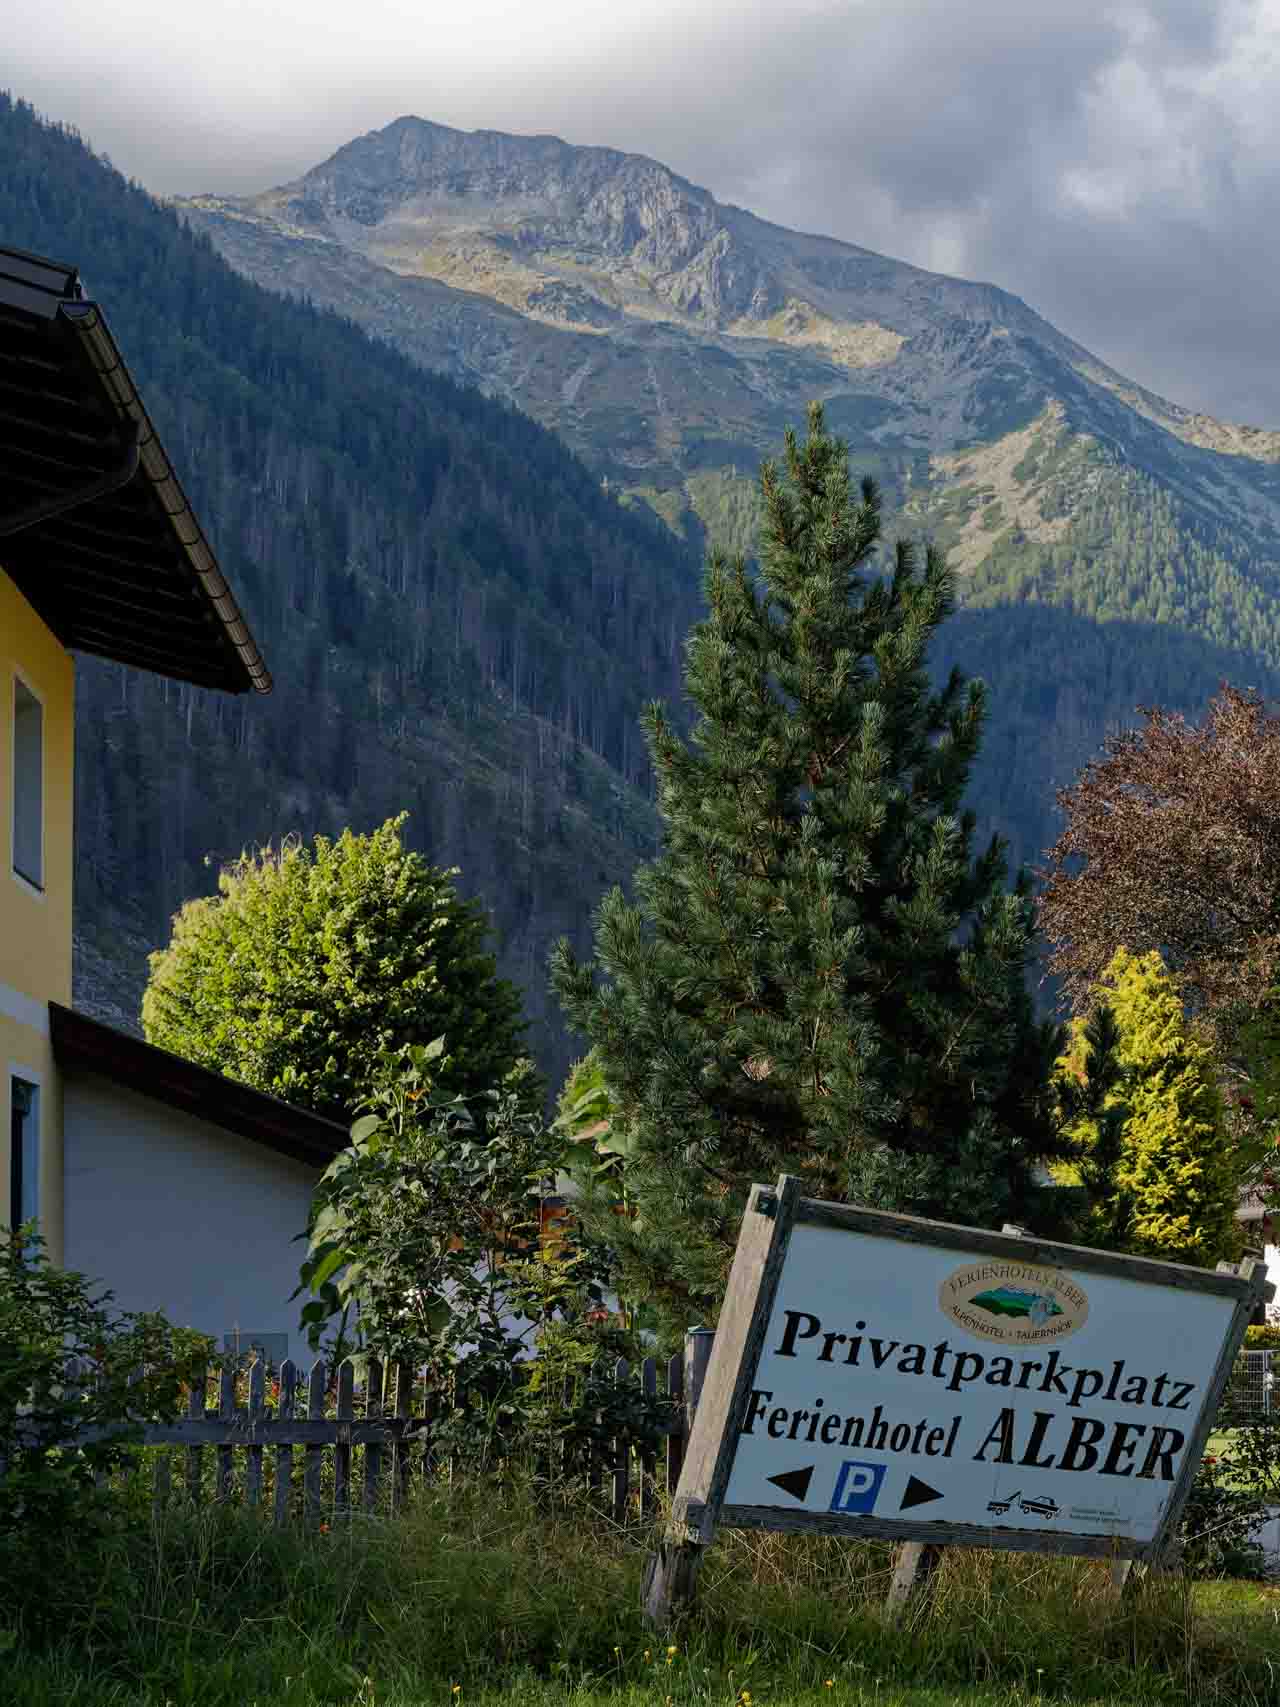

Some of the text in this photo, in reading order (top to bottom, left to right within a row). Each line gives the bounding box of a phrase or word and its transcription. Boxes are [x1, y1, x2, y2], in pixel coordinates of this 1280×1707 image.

[952, 1303, 1006, 1338] ALPENHOTEL
[773, 1310, 1196, 1410] Privatparkplatz
[743, 1389, 1186, 1482] Ferienhotel ALBER
[840, 1465, 875, 1509] P
